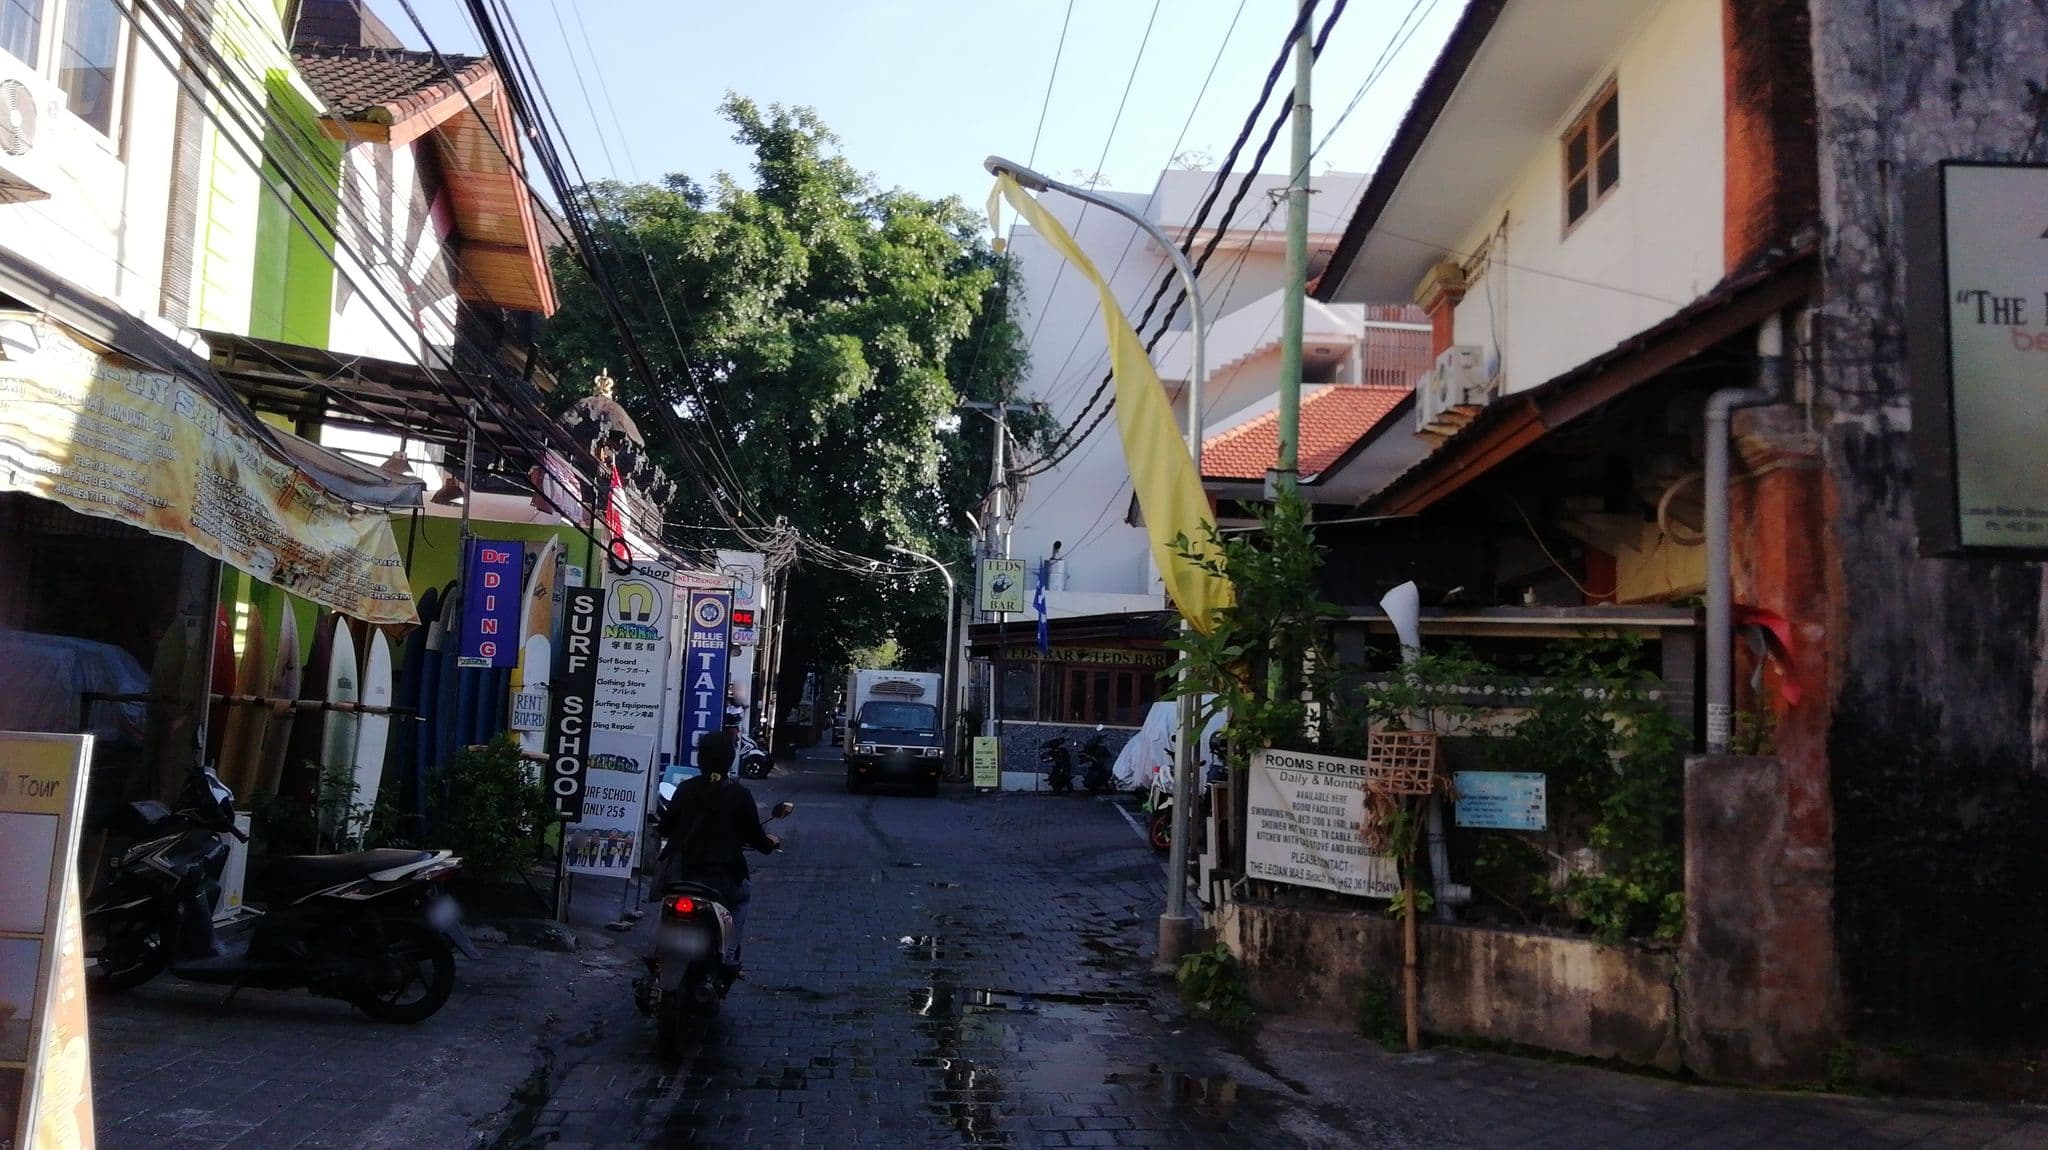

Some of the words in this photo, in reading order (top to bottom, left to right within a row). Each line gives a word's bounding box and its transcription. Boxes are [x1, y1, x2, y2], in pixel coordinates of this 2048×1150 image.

[481, 549, 511, 564] Dr.
[987, 561, 1021, 571] TEDS
[990, 600, 1015, 610] BAR
[480, 572, 500, 658] DING
[568, 595, 594, 674] SURF
[693, 631, 723, 641] BLUE
[690, 640, 725, 649] TIGER
[598, 656, 613, 665] Surf
[614, 658, 637, 666] Board
[1095, 653, 1130, 663] TEDS
[1135, 654, 1165, 665] BAR
[596, 678, 626, 688] Clothing
[626, 680, 646, 688] Store
[516, 693, 543, 711] RENT
[594, 699, 620, 709] Surfing
[621, 701, 659, 710] Equipment
[513, 711, 546, 727] BOARD
[592, 721, 610, 730] Ding
[611, 723, 635, 731] Repair
[553, 695, 584, 817] SCHOOL
[1265, 754, 1314, 770] ROOMS
[1317, 761, 1345, 774] FOR
[1280, 771, 1308, 786] Daily
[1311, 775, 1320, 785] &
[18, 775, 60, 798] Tour
[602, 787, 637, 803] SCHOOL
[1296, 790, 1329, 802] AVAILABLE
[606, 805, 626, 818] 25$
[1251, 806, 1284, 819] SWIMMING
[1292, 801, 1311, 812] ROOM
[1312, 804, 1345, 817] FACILITIES
[1261, 819, 1287, 831] SHOWER
[1321, 830, 1329, 840] TV
[1256, 831, 1281, 843] KITCHEN
[1331, 843, 1345, 854] AND
[1250, 861, 1264, 873] THE
[1264, 863, 1288, 877] LEGIAN
[1289, 867, 1304, 880] MAS
